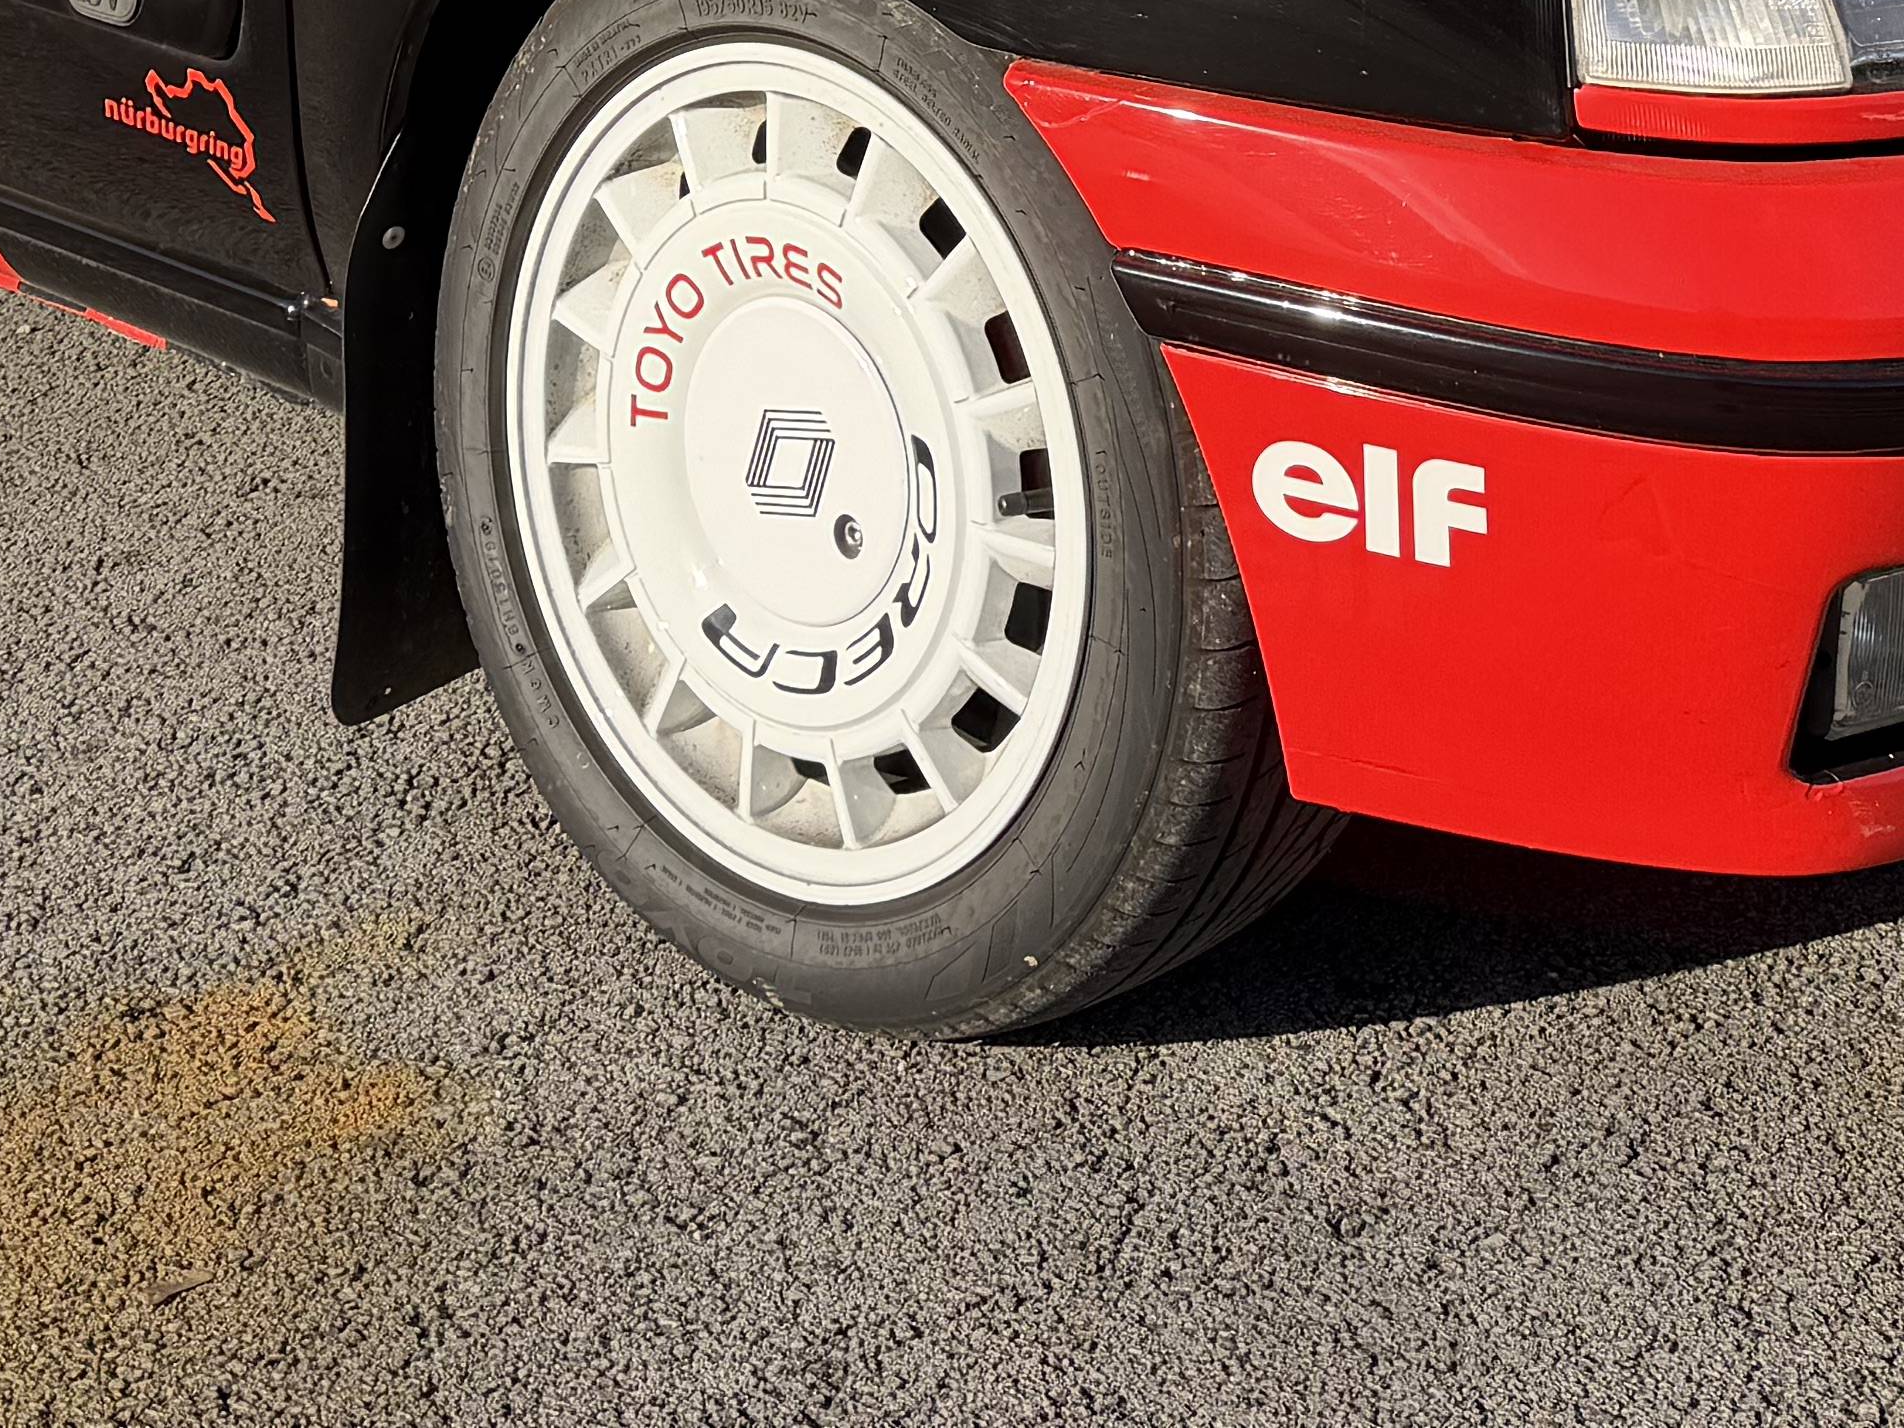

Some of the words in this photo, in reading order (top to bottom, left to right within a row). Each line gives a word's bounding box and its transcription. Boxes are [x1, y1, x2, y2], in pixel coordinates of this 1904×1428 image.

[104, 97, 244, 170] nürburgring
[629, 271, 707, 428] TOYO
[700, 235, 845, 311] TIRES
[700, 433, 937, 697] ORECA
[1250, 438, 1488, 568] elf
